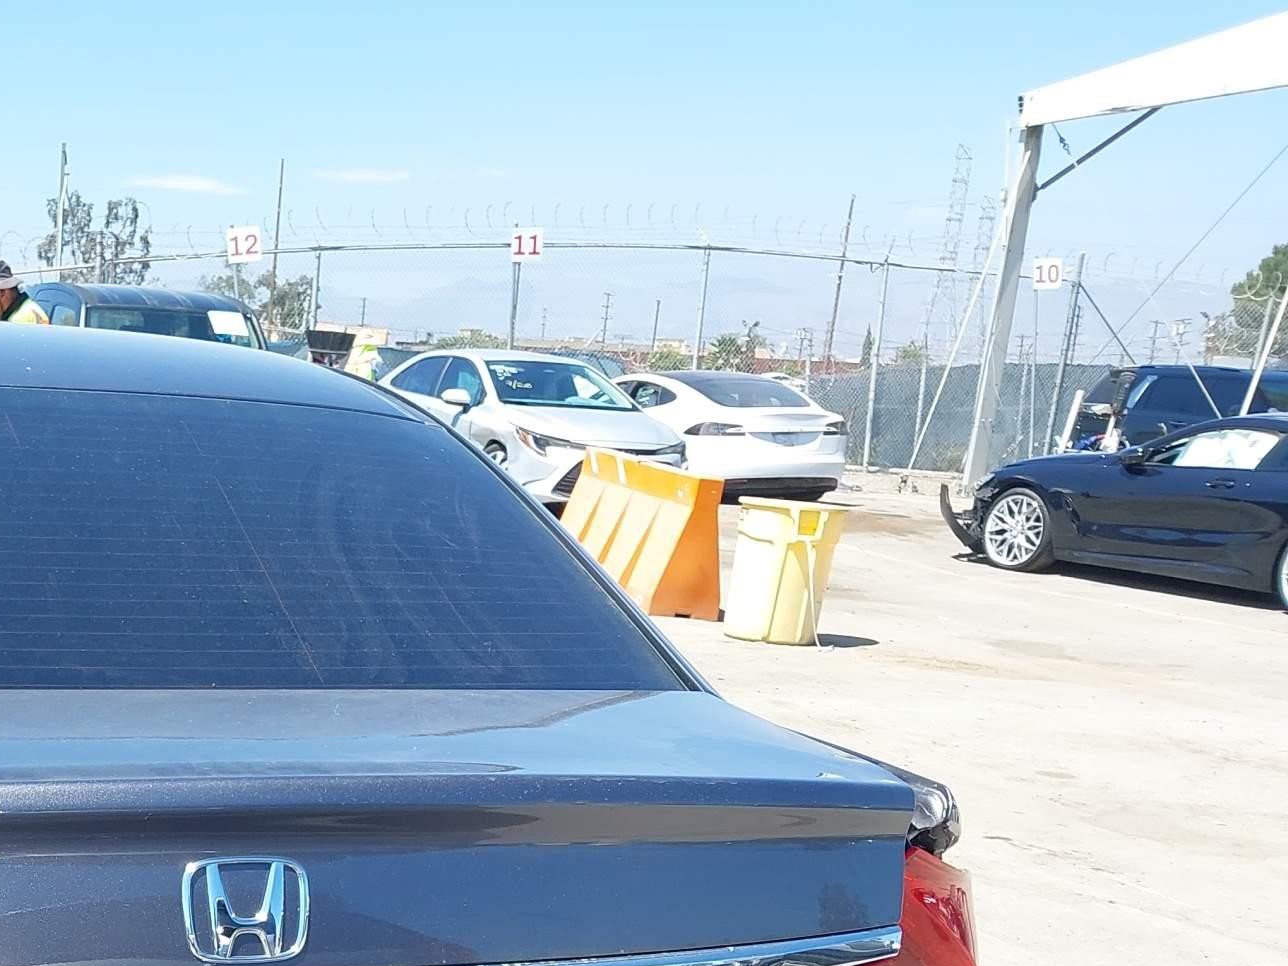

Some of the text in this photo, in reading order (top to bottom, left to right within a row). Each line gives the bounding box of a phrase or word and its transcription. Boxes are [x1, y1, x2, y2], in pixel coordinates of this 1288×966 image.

[229, 234, 259, 256] 12
[513, 234, 540, 255] 11
[1035, 264, 1059, 283] 10
